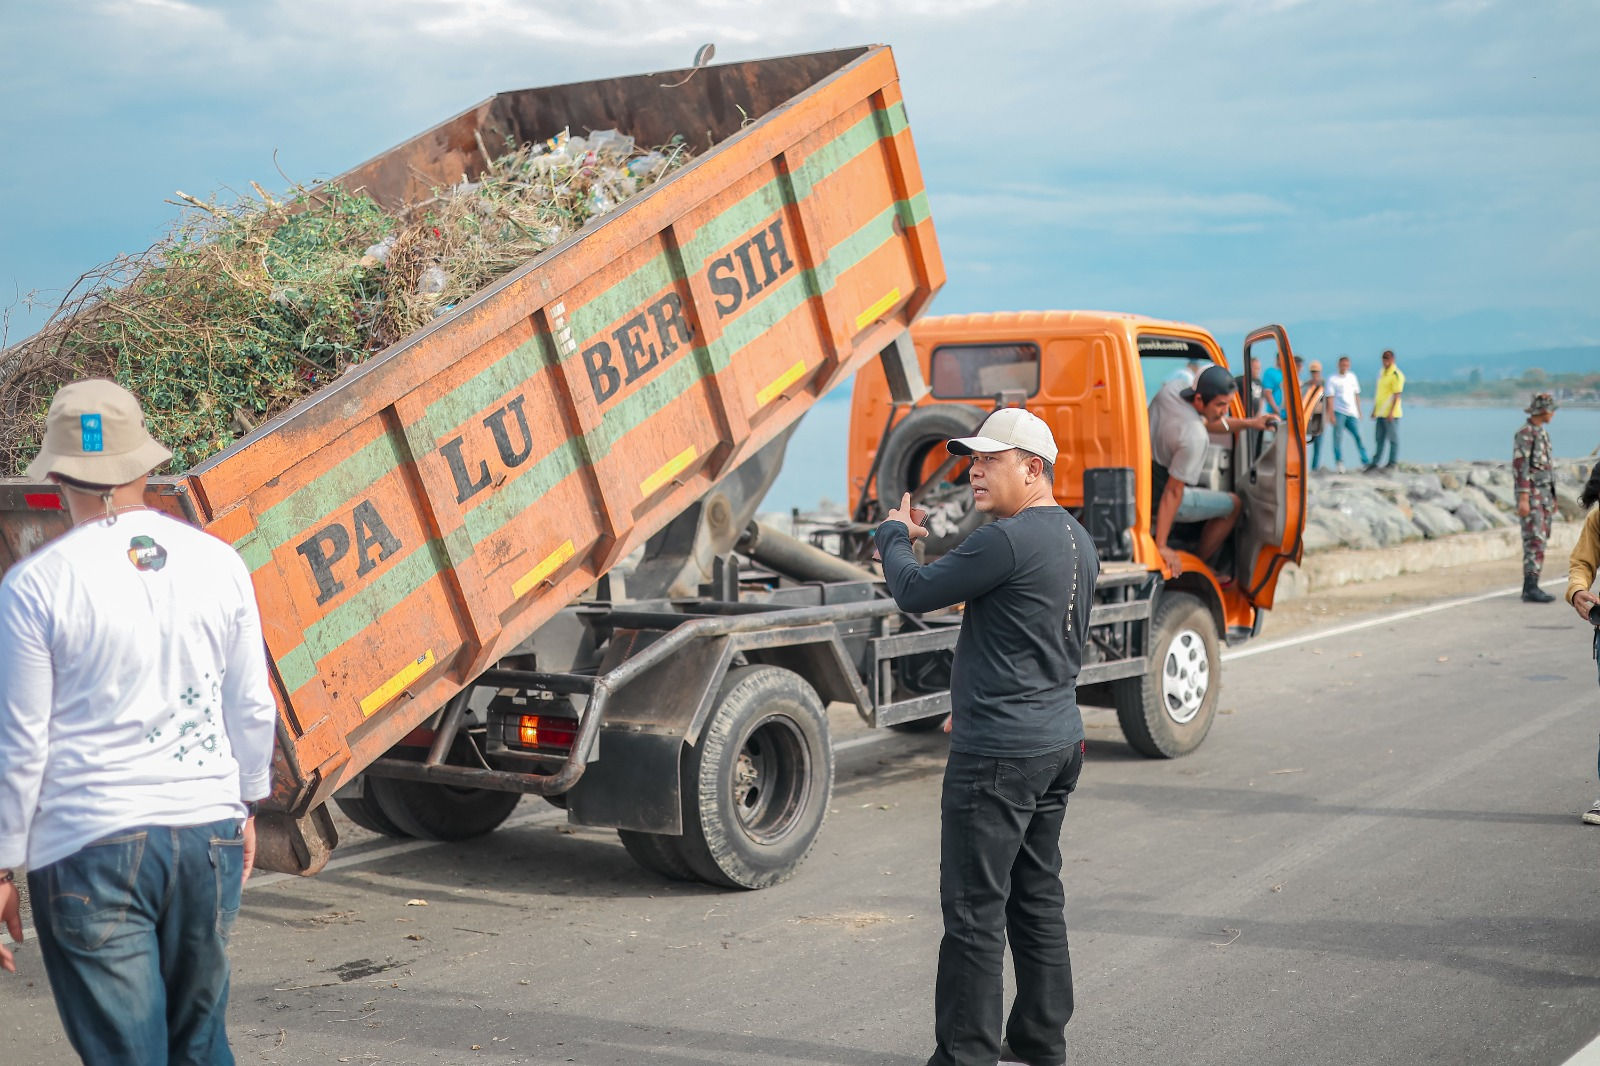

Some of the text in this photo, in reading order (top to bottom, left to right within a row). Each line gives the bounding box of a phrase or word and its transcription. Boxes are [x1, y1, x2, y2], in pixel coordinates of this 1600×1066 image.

[296, 217, 794, 607] PA LU BER SIH
